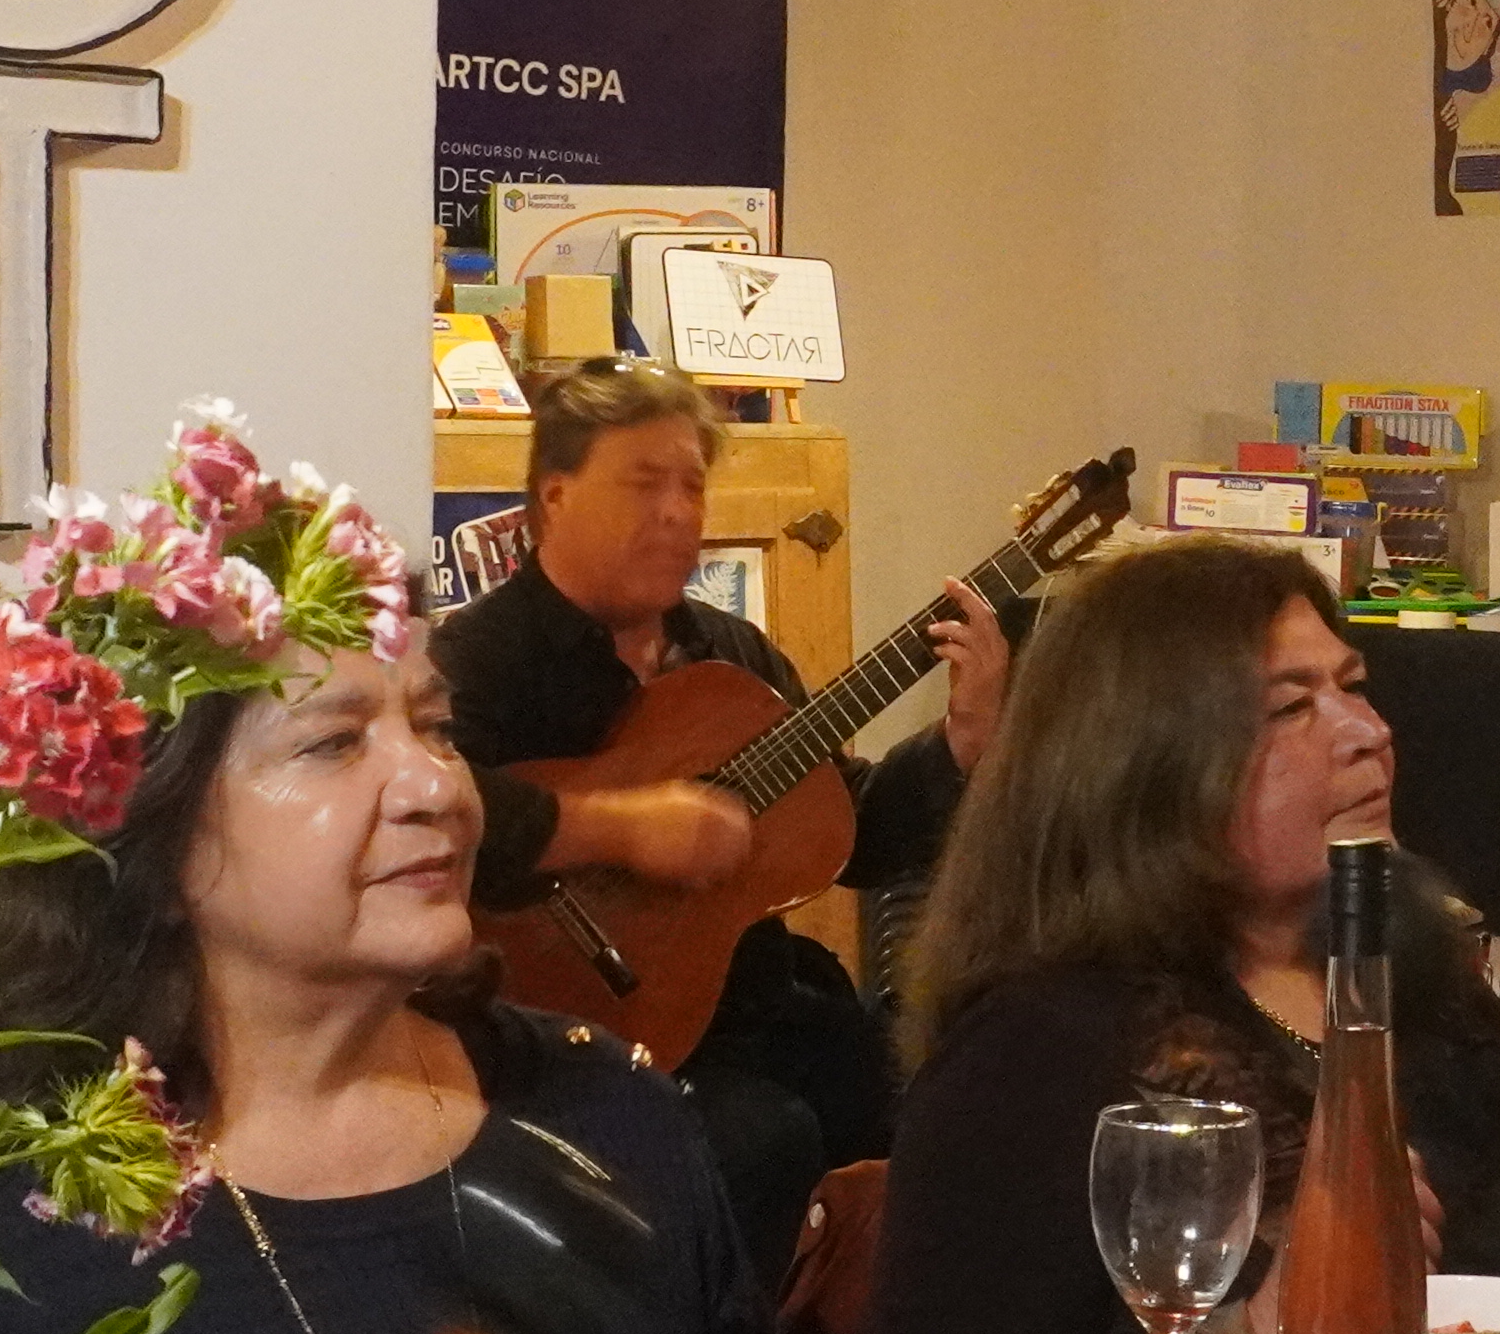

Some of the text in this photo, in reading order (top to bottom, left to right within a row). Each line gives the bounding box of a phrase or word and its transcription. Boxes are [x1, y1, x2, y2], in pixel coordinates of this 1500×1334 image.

[557, 64, 626, 104] SPA
[439, 141, 601, 165] CONCURSO NACIONAL
[746, 197, 765, 212] 8+
[1348, 396, 1451, 413] FRACTION STAX
